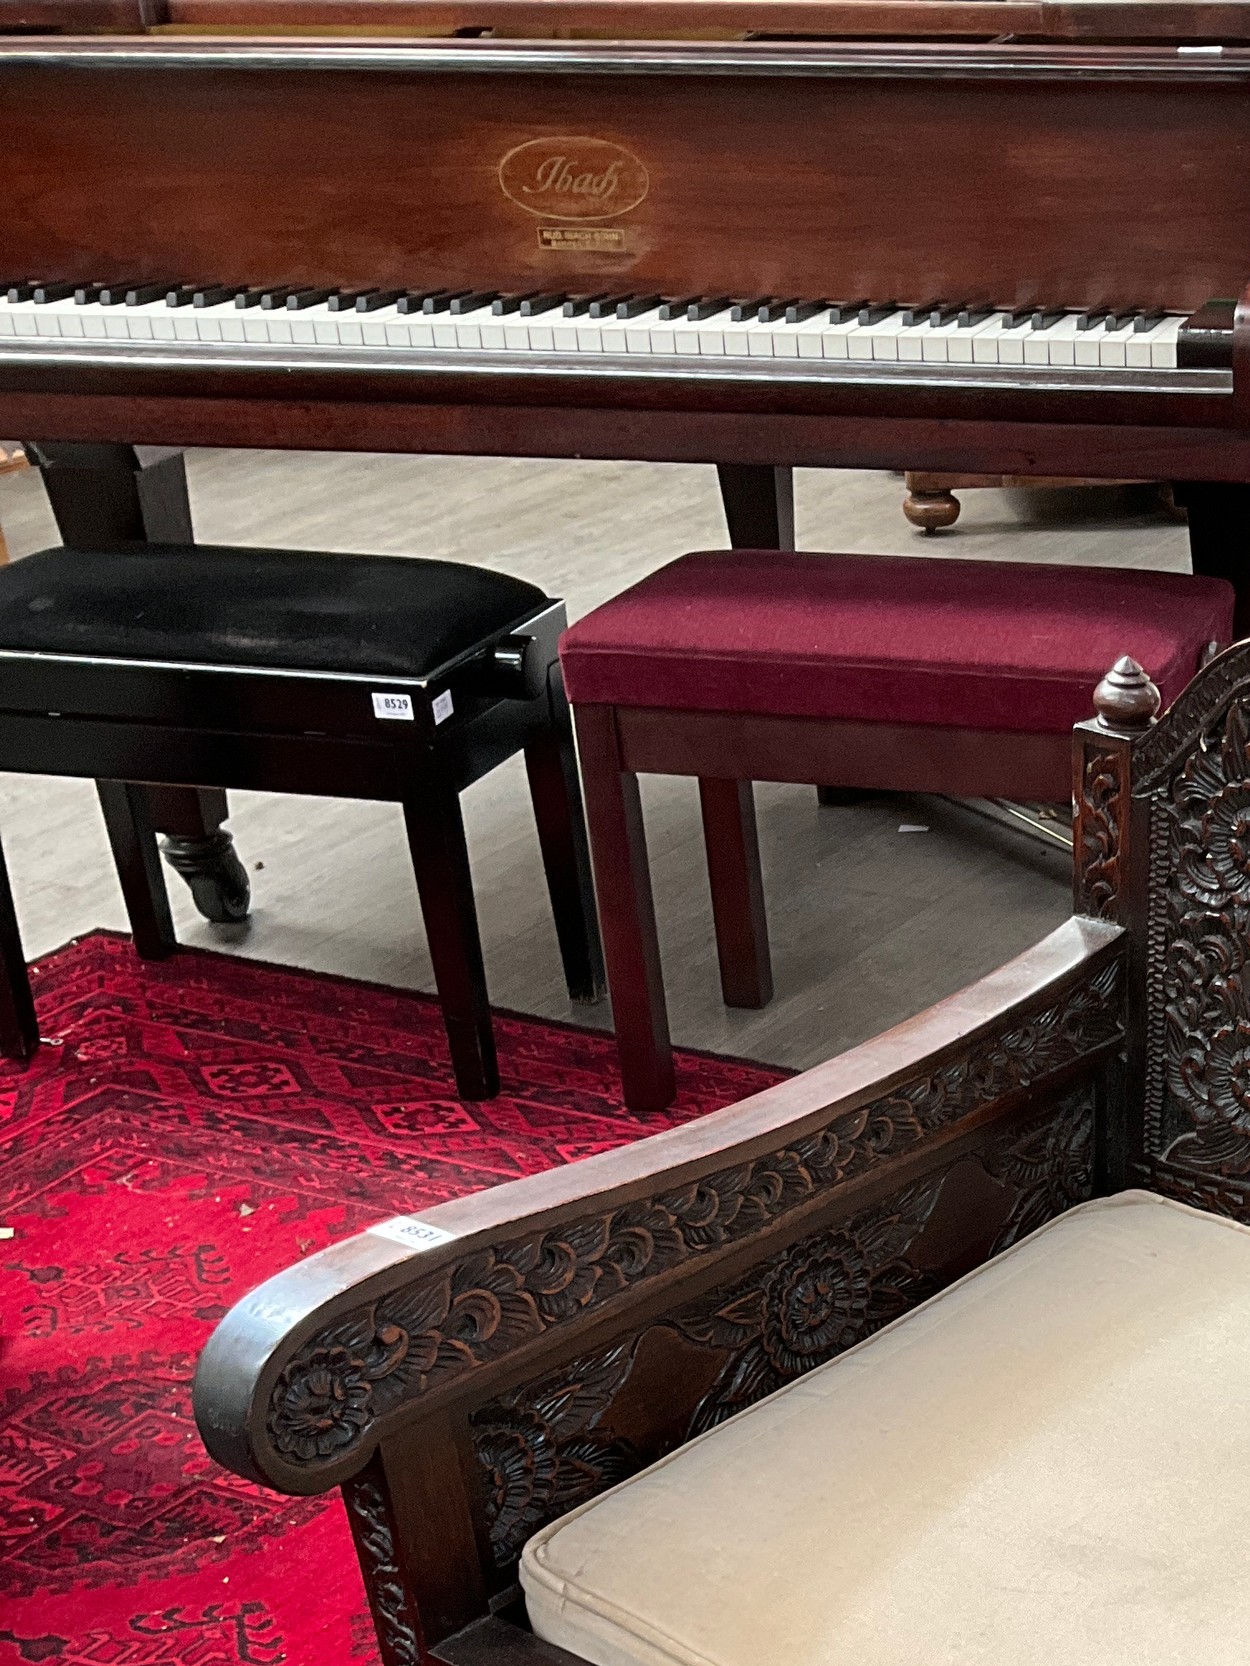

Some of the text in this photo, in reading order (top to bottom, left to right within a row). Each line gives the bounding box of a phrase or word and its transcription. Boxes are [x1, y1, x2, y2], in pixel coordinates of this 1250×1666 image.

[522, 156, 624, 200] Ibach
[384, 698, 408, 709] 8529
[400, 1225, 442, 1242] 8531
